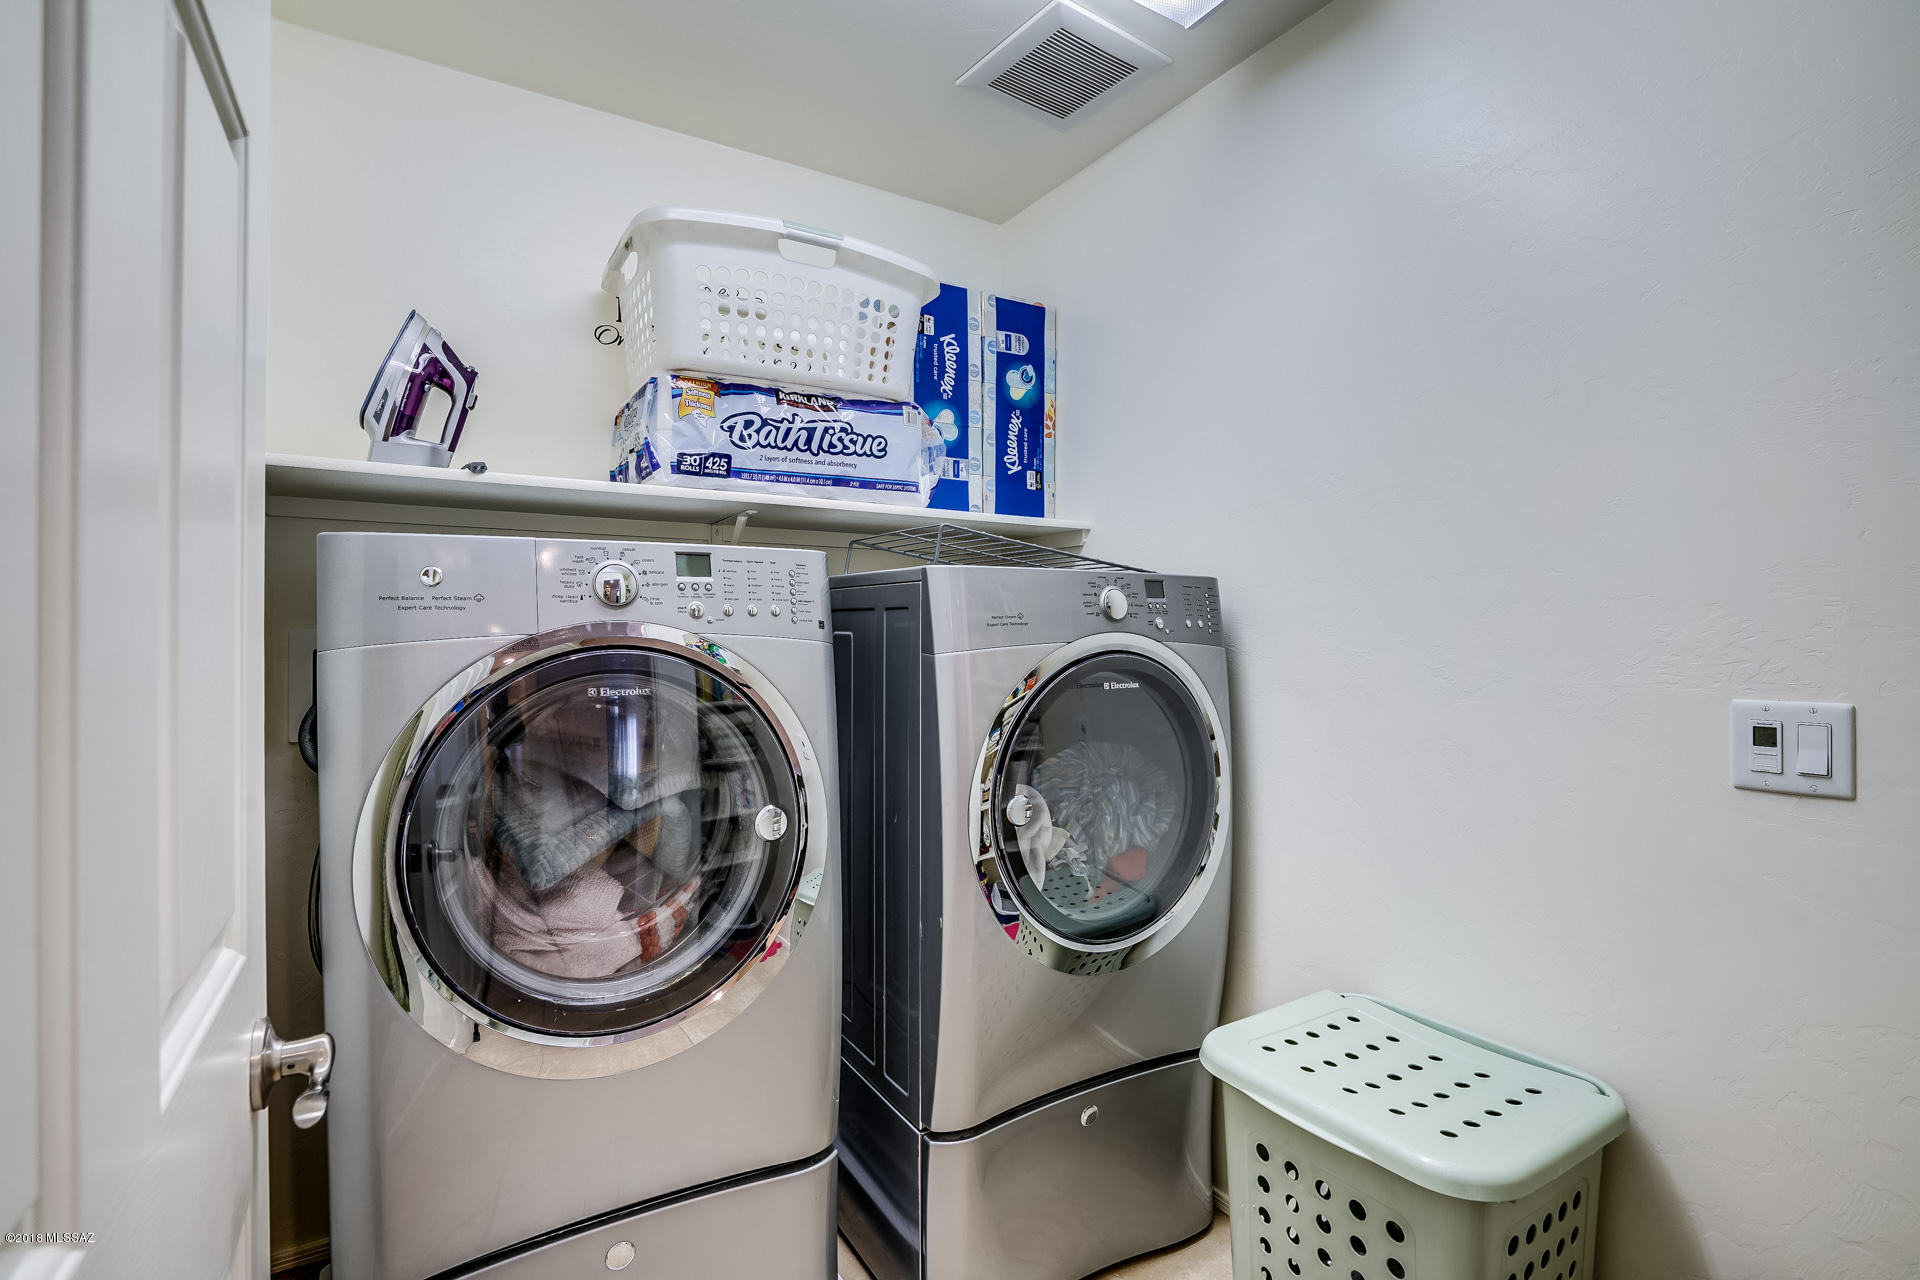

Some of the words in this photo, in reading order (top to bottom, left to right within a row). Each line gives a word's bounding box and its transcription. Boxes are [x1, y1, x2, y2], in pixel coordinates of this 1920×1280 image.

[940, 334, 960, 397] Kleenex
[686, 388, 711, 399] Softness
[779, 392, 835, 406] KIRKLAND
[684, 399, 712, 411] Thickness
[1004, 412, 1022, 474] Kleenex
[682, 456, 699, 465] 30
[706, 457, 728, 470] 425
[764, 455, 780, 464] layers
[789, 457, 814, 465] softness
[827, 460, 857, 469] absorbency
[1110, 681, 1139, 689] Electrolux
[600, 687, 651, 696] Electrolux
